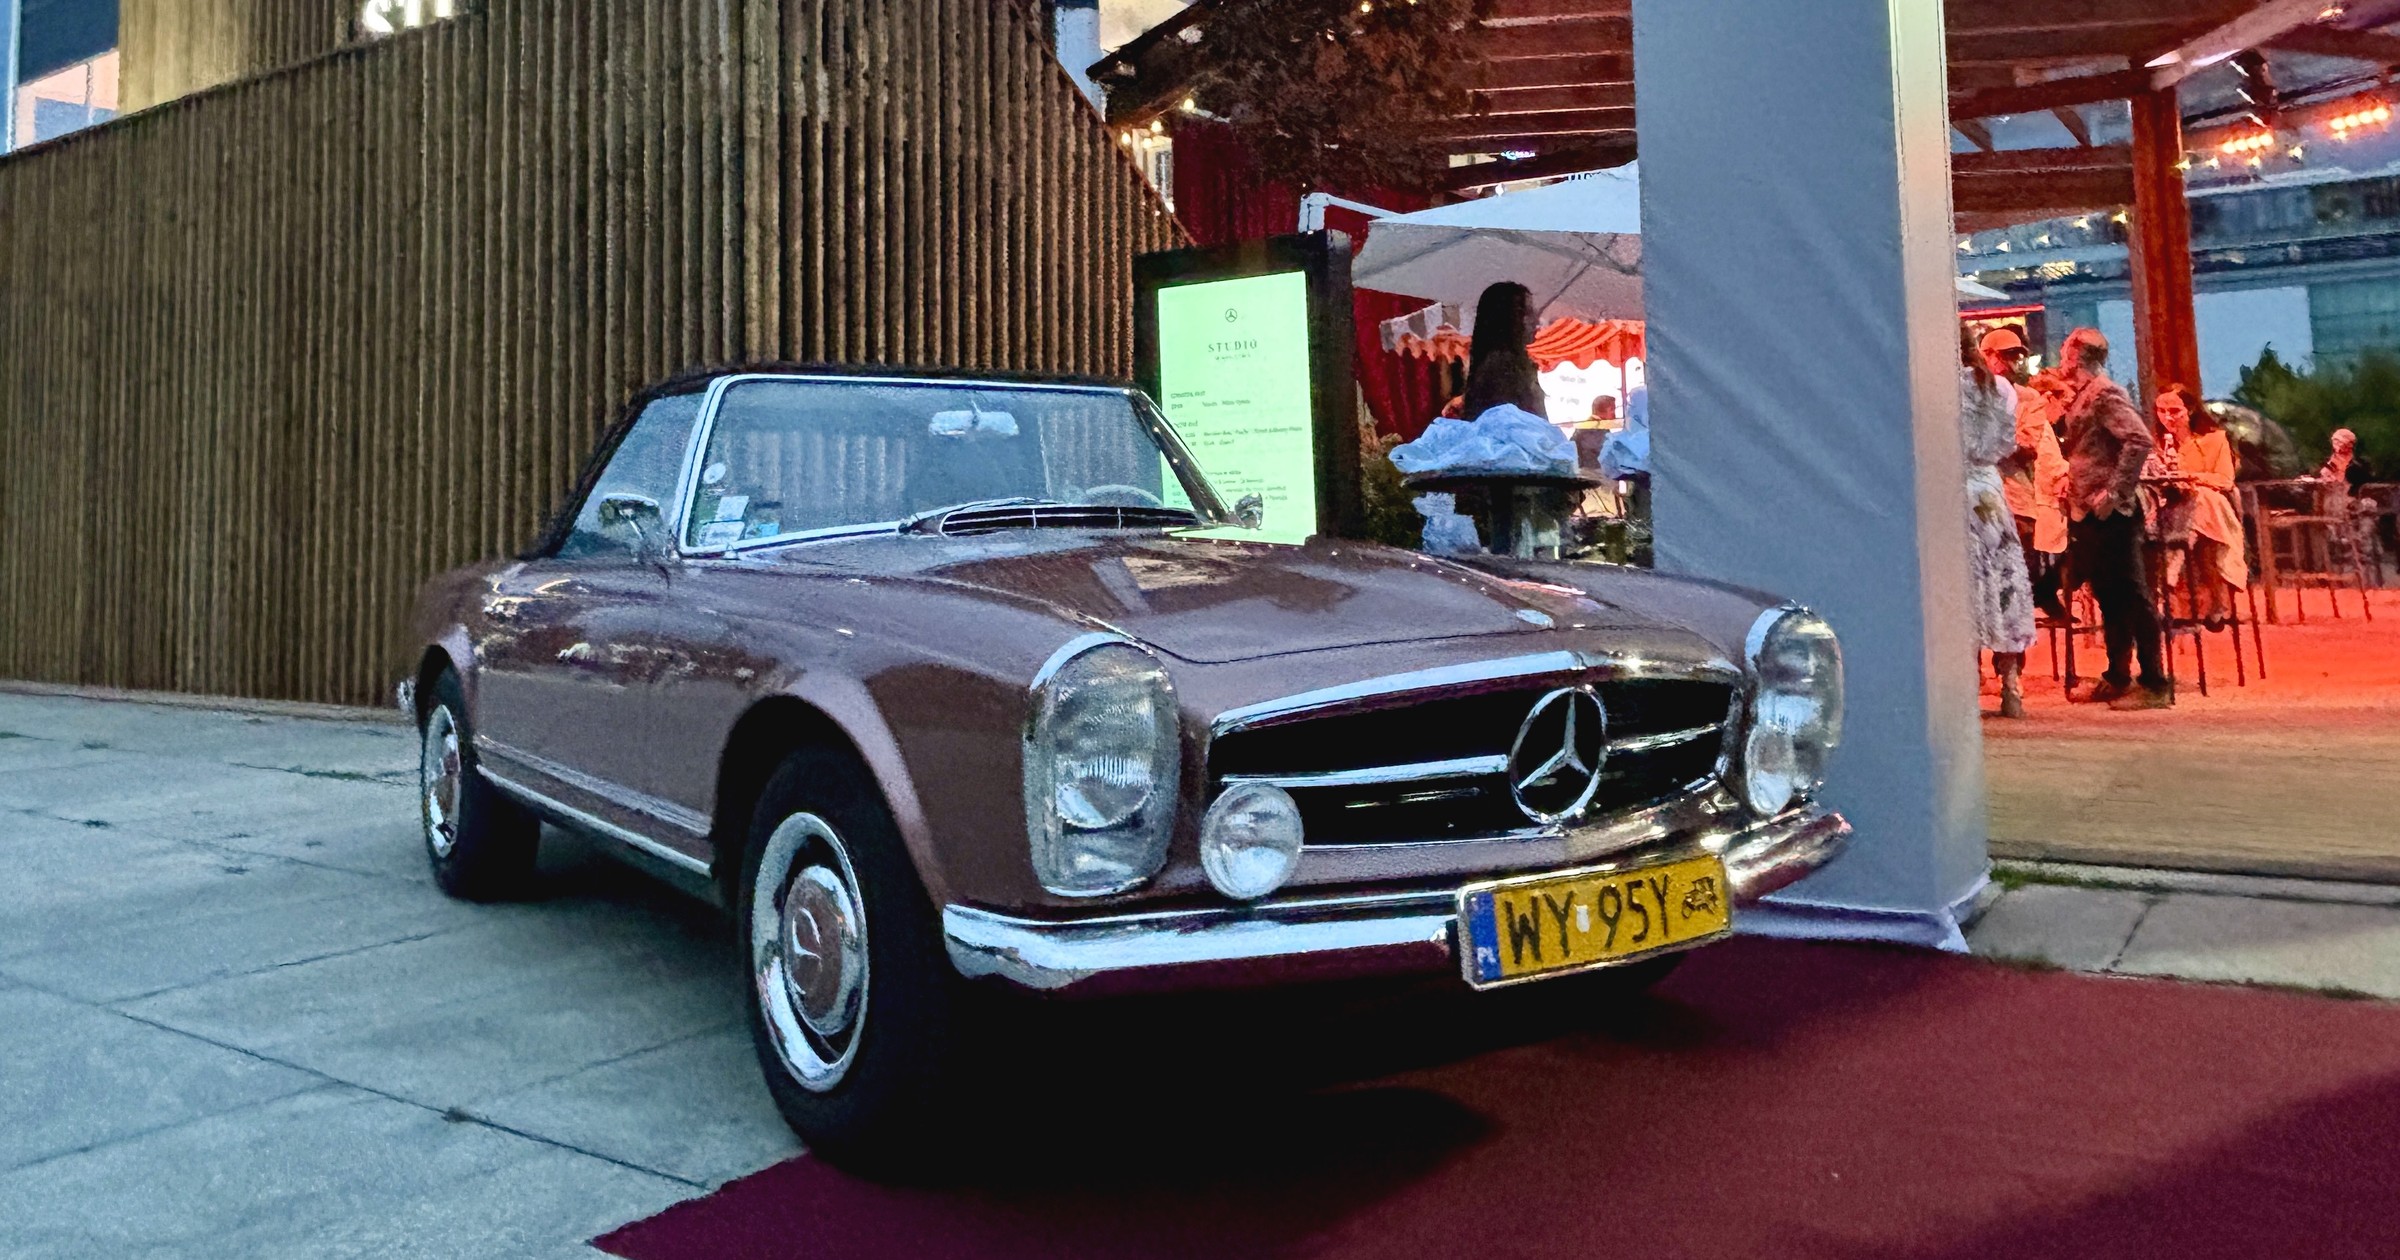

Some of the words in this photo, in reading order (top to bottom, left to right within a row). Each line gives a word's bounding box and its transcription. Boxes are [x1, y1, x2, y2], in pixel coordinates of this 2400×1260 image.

[1208, 340, 1257, 352] STUDIO
[1505, 890, 1576, 965] WY
[1598, 874, 1671, 950] 95Y
